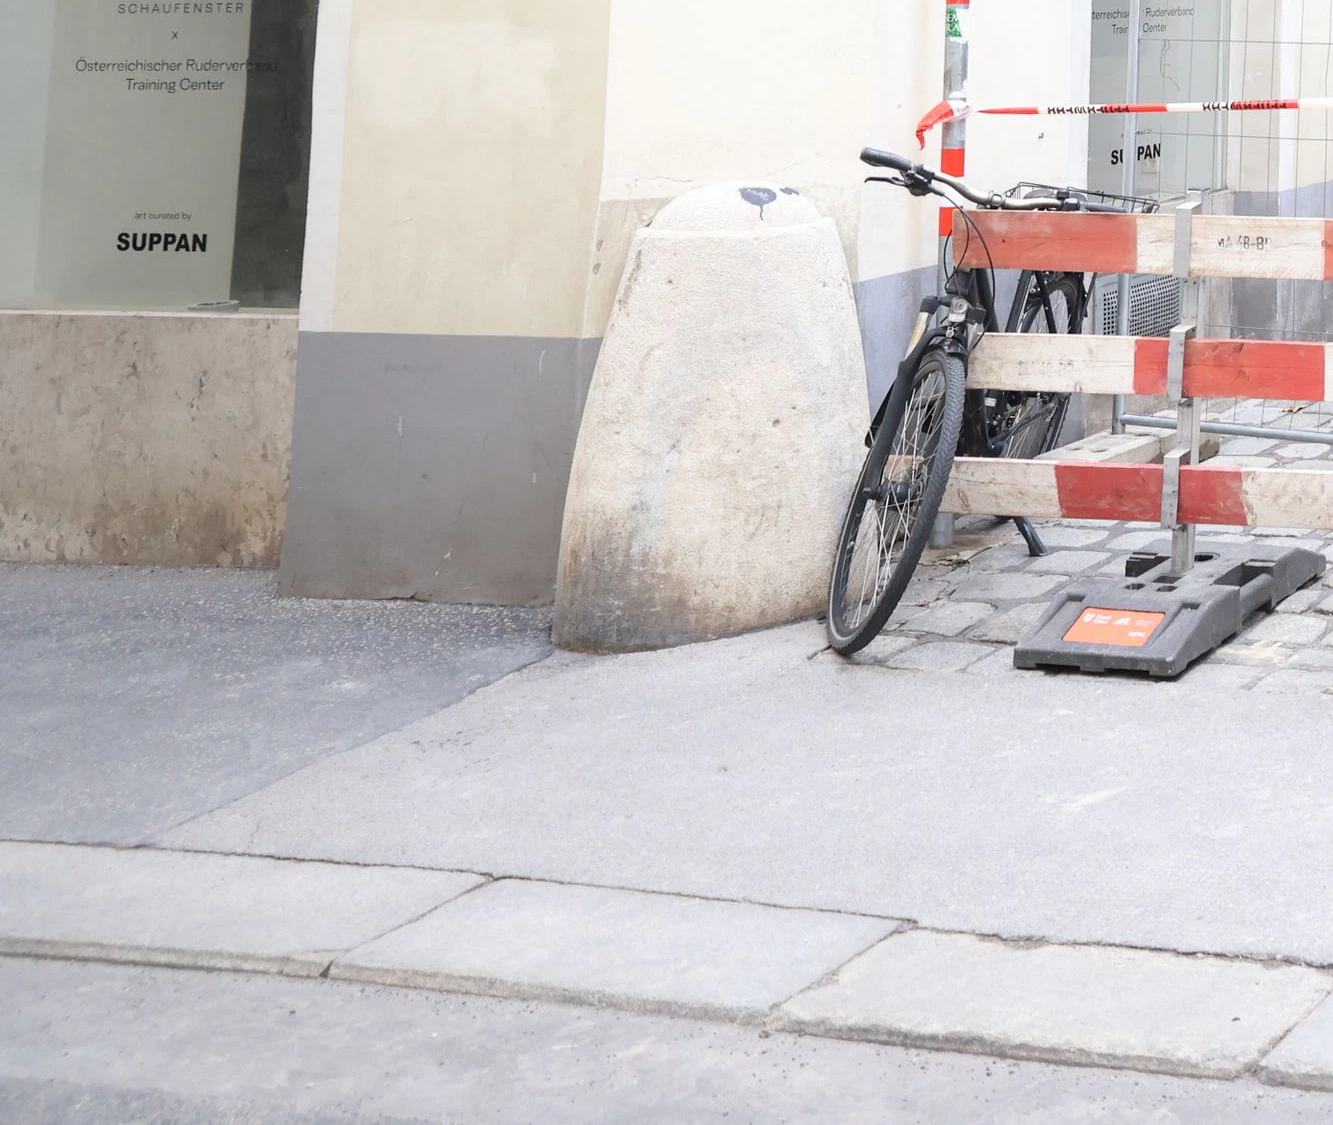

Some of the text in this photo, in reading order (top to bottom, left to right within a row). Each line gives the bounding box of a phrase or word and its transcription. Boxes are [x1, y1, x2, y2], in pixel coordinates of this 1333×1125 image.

[118, 2, 245, 15] SCHAUFENSTER
[75, 57, 183, 73] Österreichischer
[126, 77, 226, 94] Training Center
[116, 232, 208, 253] SUPPAN
